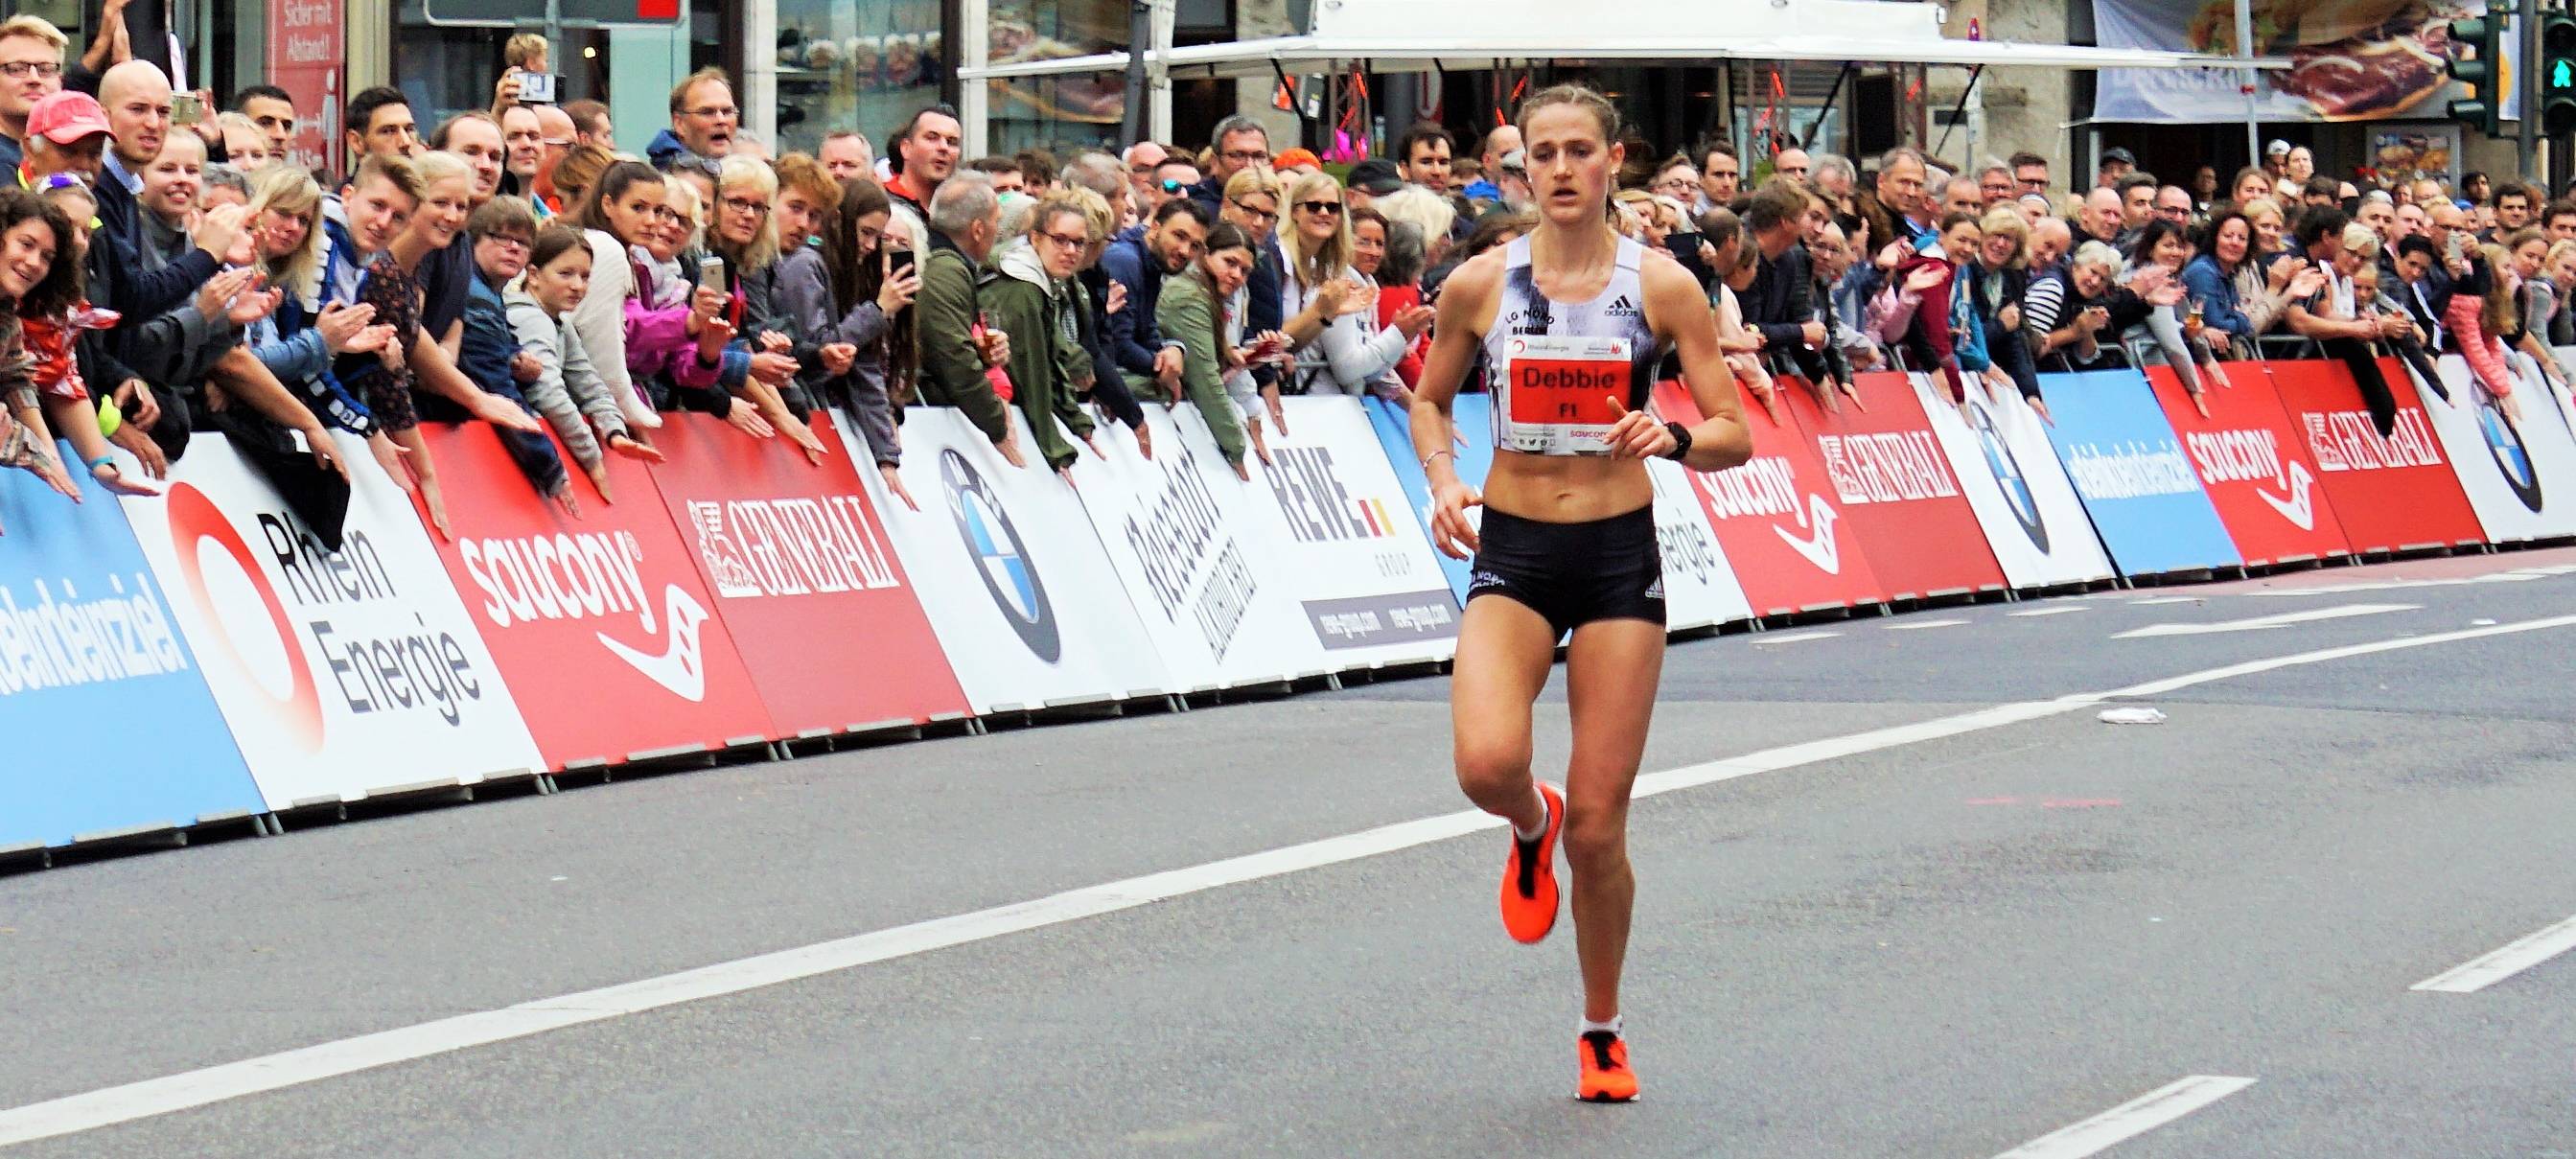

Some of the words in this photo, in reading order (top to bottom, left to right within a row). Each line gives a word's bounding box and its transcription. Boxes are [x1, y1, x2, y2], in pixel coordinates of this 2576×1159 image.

[1522, 367, 1615, 389] Debbie
[1254, 447, 1369, 543] REWE
[1845, 429, 1959, 502] GENERALI
[256, 511, 397, 605] Rhein
[727, 494, 901, 596] GENERALI
[310, 612, 480, 727] Energie
